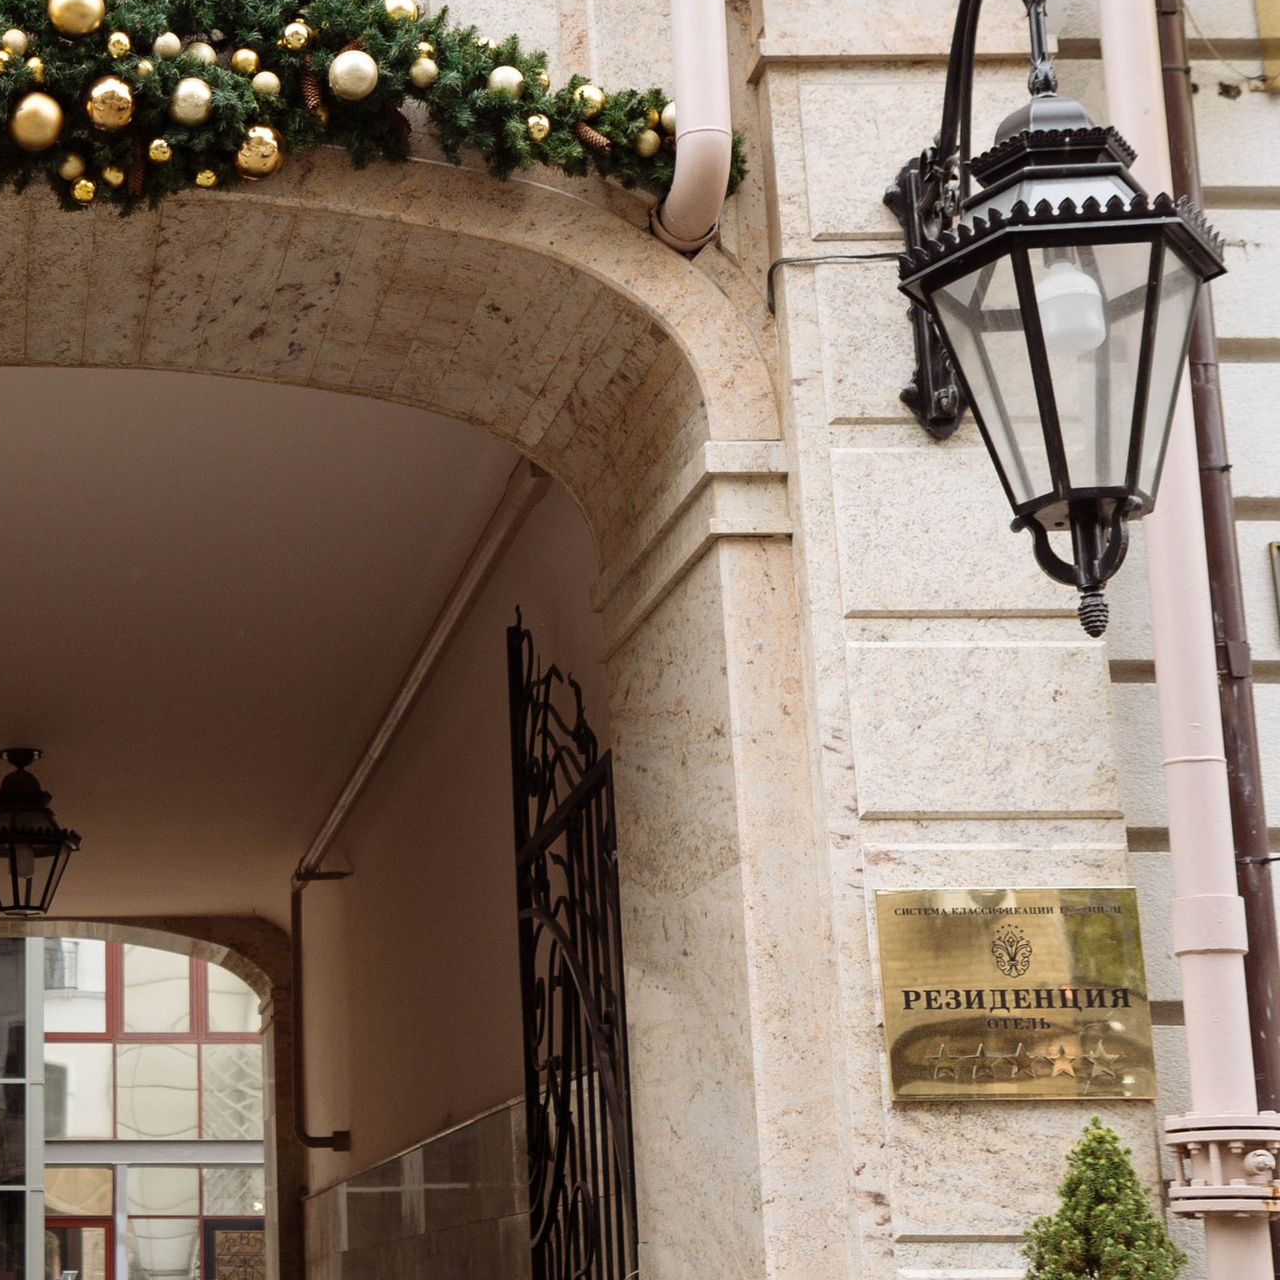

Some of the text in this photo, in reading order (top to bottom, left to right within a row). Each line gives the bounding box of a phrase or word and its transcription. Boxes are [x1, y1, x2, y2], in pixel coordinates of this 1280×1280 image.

[894, 907, 947, 916] СИСТЕМА
[951, 906, 1054, 916] КЛАССИФИКАЦИИ
[901, 987, 1132, 1013] РЕЗИДЕНЦИЯ
[986, 1017, 1051, 1030] ОТЕЛЬ
